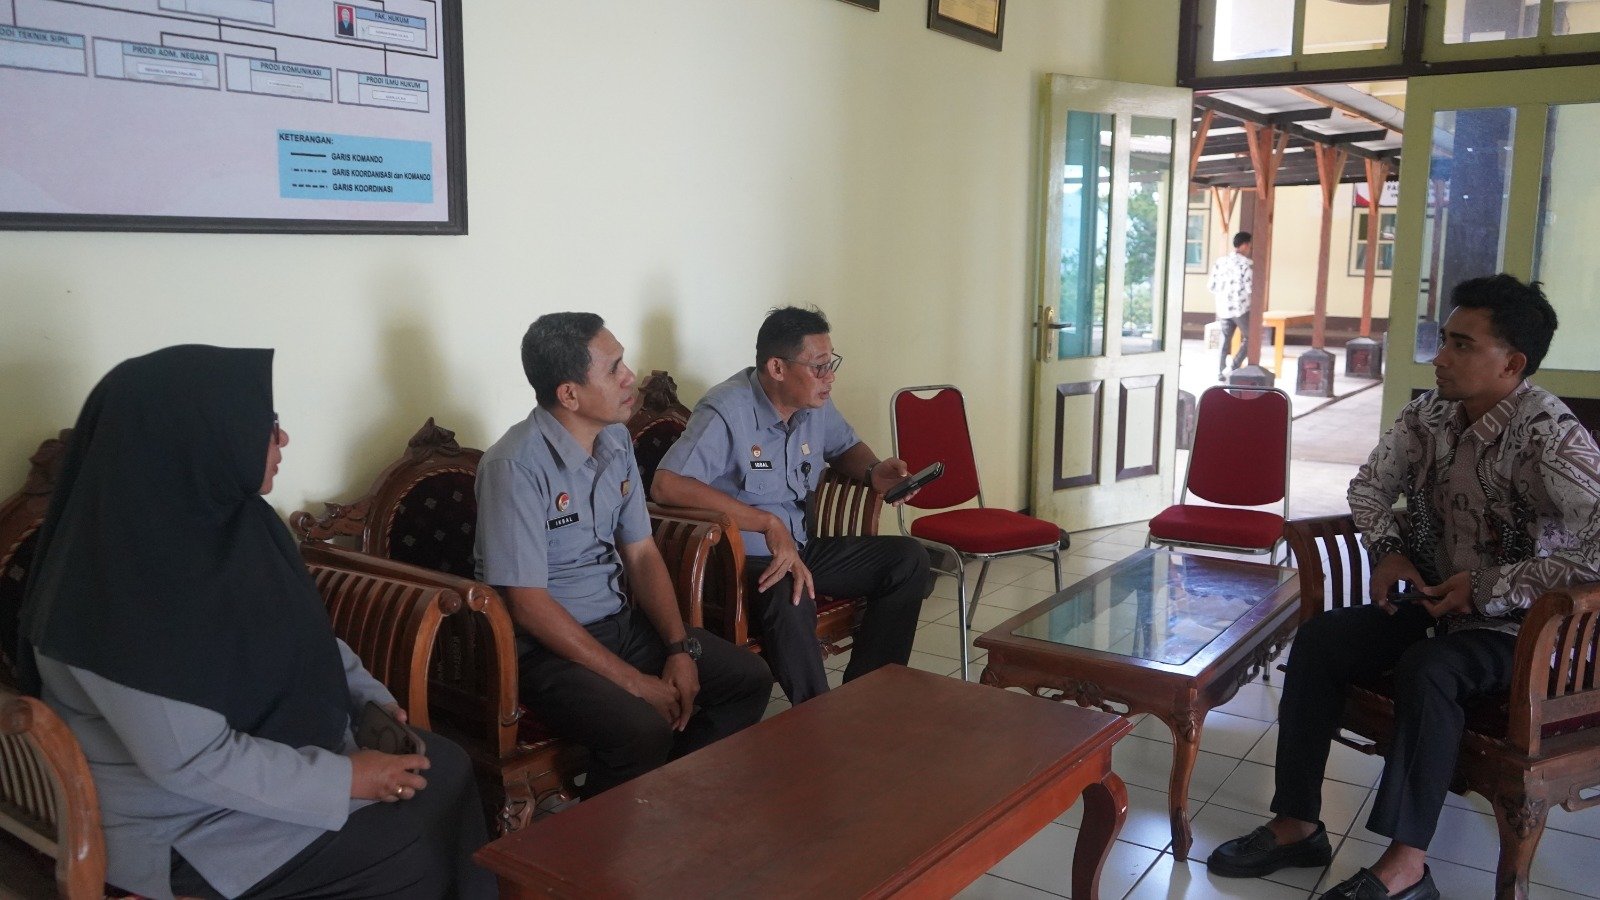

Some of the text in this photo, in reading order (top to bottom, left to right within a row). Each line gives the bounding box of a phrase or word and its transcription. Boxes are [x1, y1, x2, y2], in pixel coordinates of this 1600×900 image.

[388, 14, 410, 25] HUKUM
[132, 45, 157, 56] PRODI
[180, 51, 210, 62] NEGARA
[260, 61, 322, 76] PRODI KOMUNIKASI
[366, 76, 421, 89] PRODI ILMU HUKUM
[279, 133, 333, 144] KETERANGAN:
[331, 153, 383, 163] GARIS KOMANDO
[332, 169, 350, 177] GARIS
[351, 170, 393, 179] KOORDANISASI
[404, 172, 431, 181] KOMANDO
[332, 183, 393, 193] GARIS KOORDINASI
